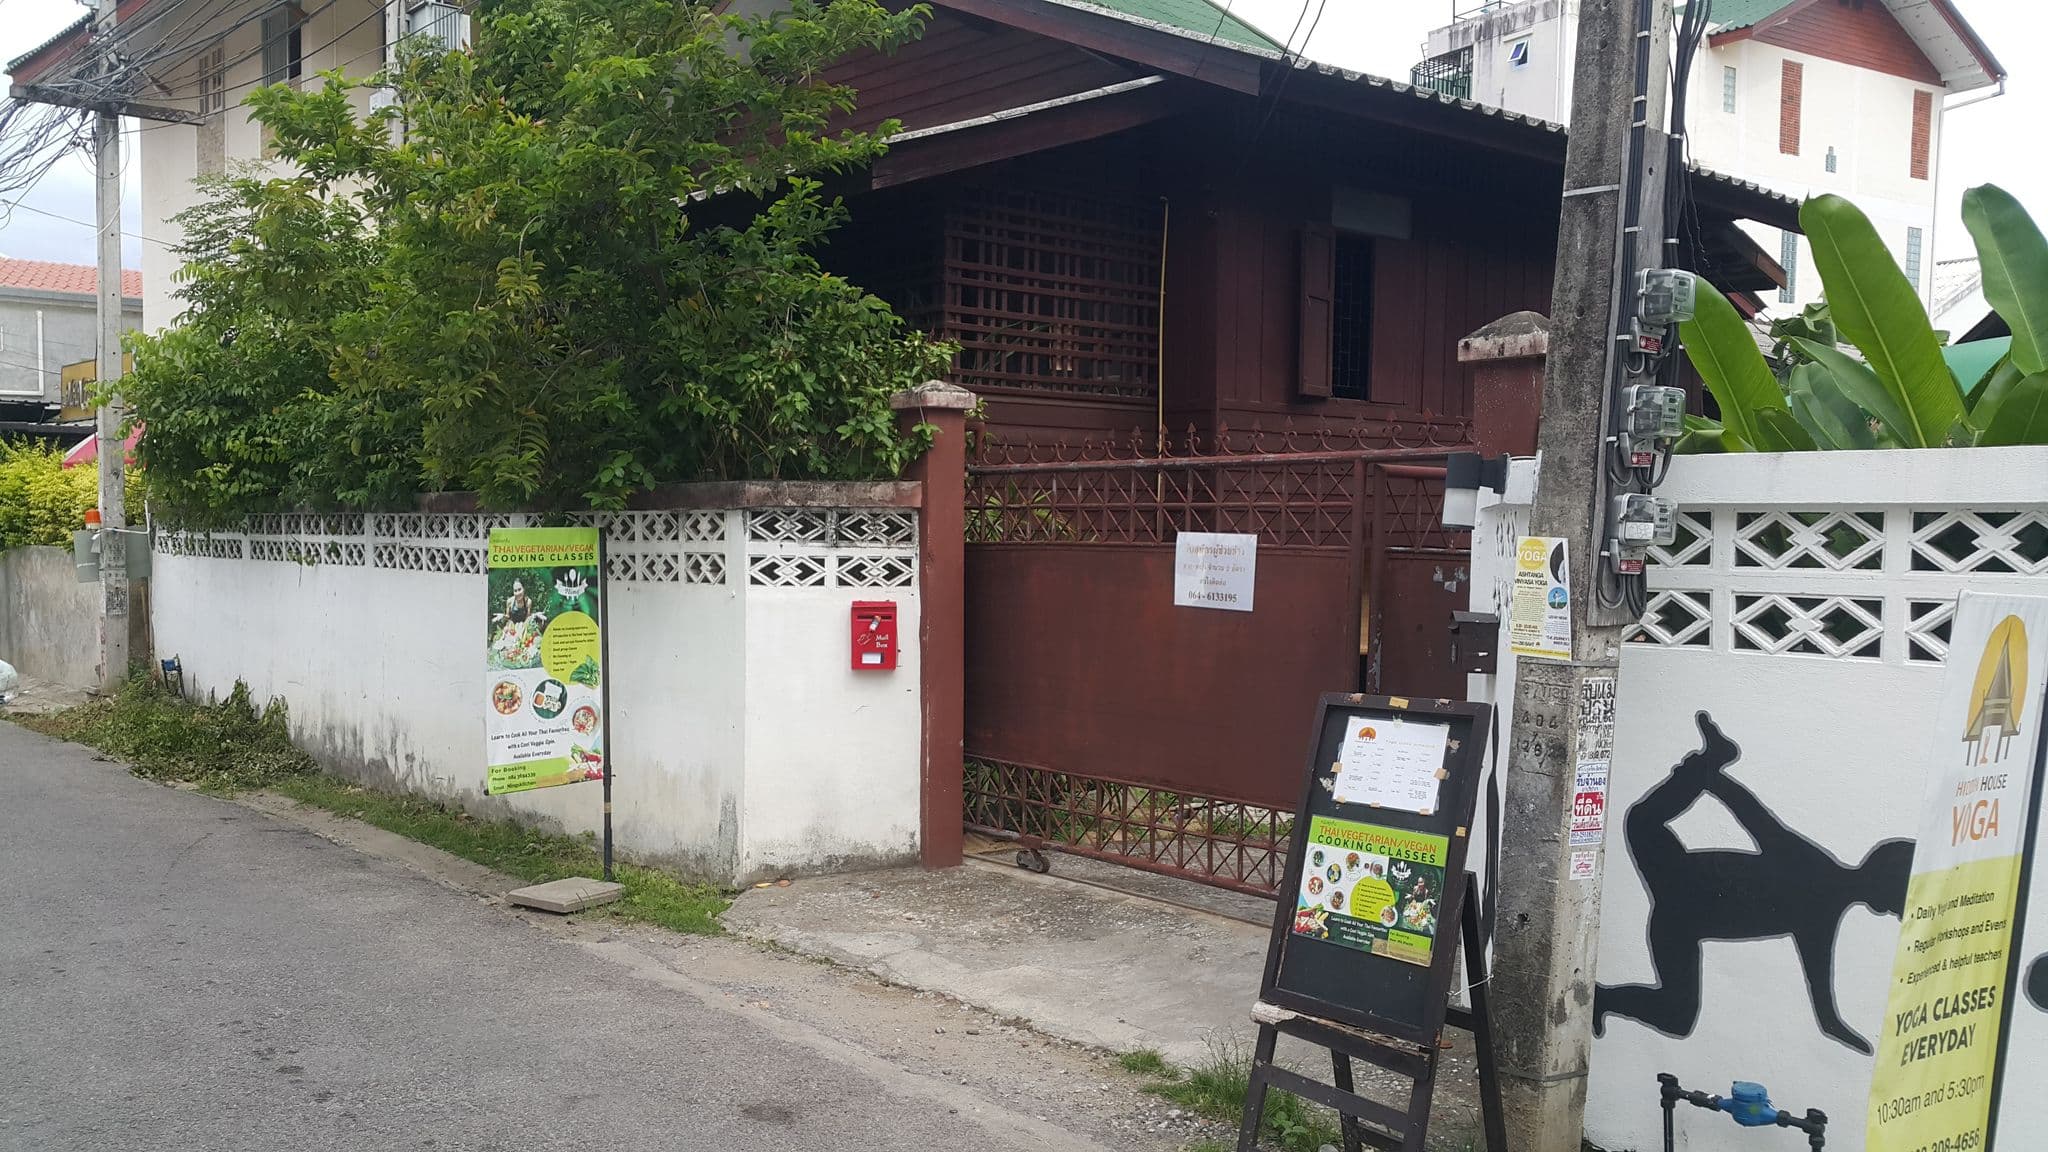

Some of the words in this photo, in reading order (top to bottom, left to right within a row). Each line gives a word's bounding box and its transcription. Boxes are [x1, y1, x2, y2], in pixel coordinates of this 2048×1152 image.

[492, 553, 545, 563] COOKING
[549, 552, 594, 562] CLASSES
[494, 545, 514, 554] THAI
[1517, 550, 1548, 562] YOGA
[1980, 774, 2008, 792] HOUSE
[1952, 798, 1999, 847] YOGA
[1317, 834, 1373, 852] COOKING
[1379, 845, 1436, 864] CLASSES
[1319, 825, 1340, 838] THAI
[1341, 829, 1437, 853] VEGETARIAN/VEGAN
[1916, 906, 1936, 920] Daily
[1959, 891, 1995, 907] Meditation
[1971, 921, 1984, 934] and
[1985, 919, 2008, 932] Evens
[1895, 1002, 1928, 1037] YOGA
[1933, 985, 1996, 1022] CLASSES
[1900, 1023, 1977, 1067] EVERYDAY
[1877, 1095, 1922, 1126] 10:30am
[1924, 1083, 1945, 1109] and
[1946, 1075, 1985, 1101] 5:30pm
